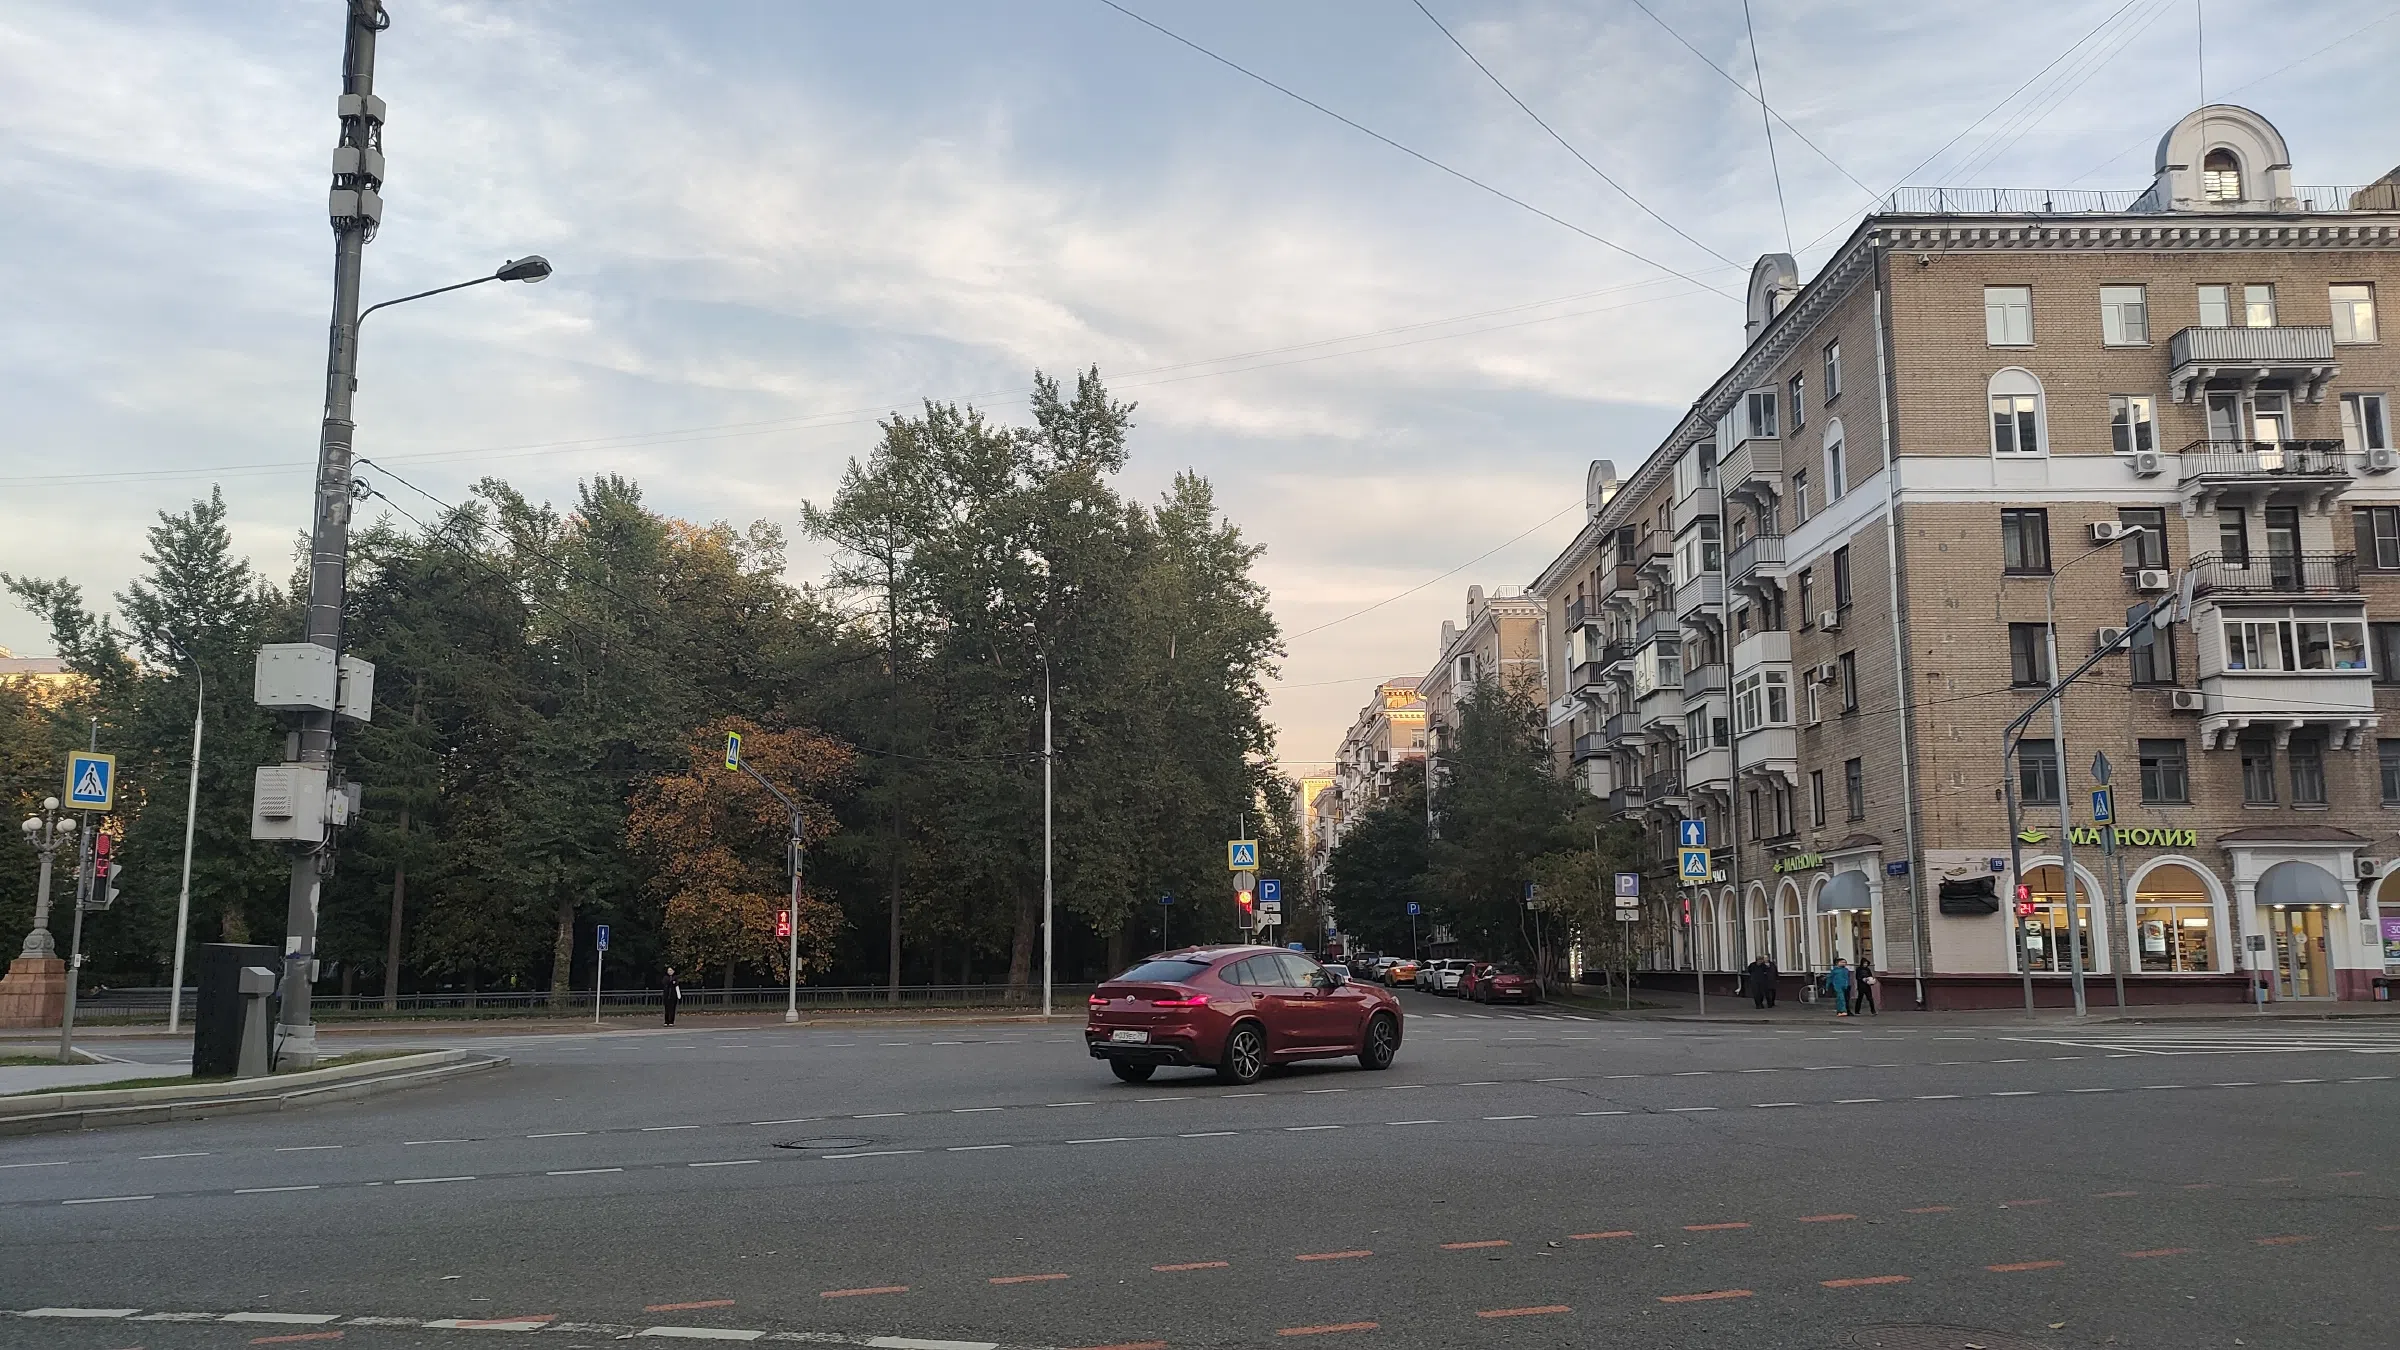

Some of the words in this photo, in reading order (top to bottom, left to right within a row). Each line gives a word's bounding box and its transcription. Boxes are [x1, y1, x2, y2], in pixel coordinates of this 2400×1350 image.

[2068, 827, 2197, 847] МАНОЛИЯ
[1264, 883, 1276, 899] P
[1621, 876, 1633, 893] P
[1410, 903, 1417, 914] P
